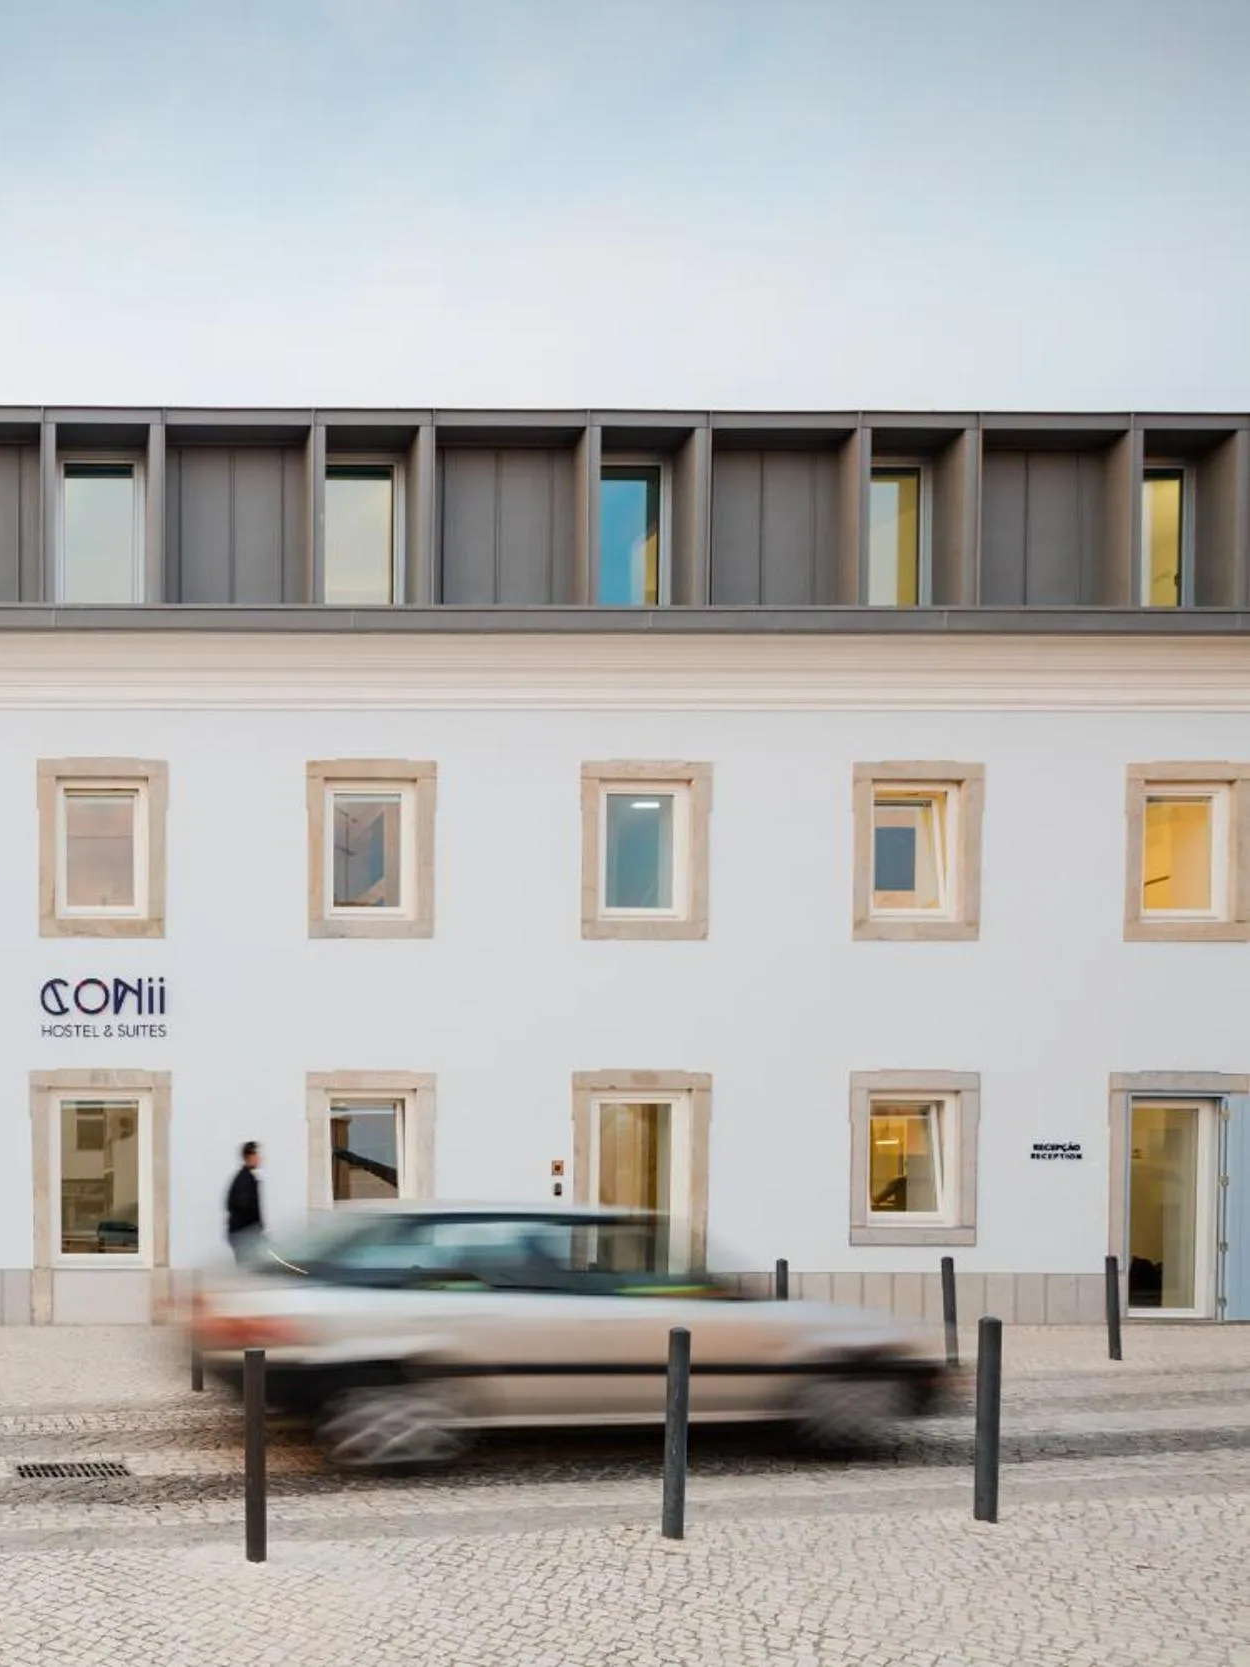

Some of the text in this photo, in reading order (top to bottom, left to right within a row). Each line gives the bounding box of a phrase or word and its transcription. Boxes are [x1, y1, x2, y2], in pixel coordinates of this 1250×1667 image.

[41, 1024, 167, 1038] HOSTEL & SUITES
[1033, 1142, 1081, 1152] RECEPÇÃO
